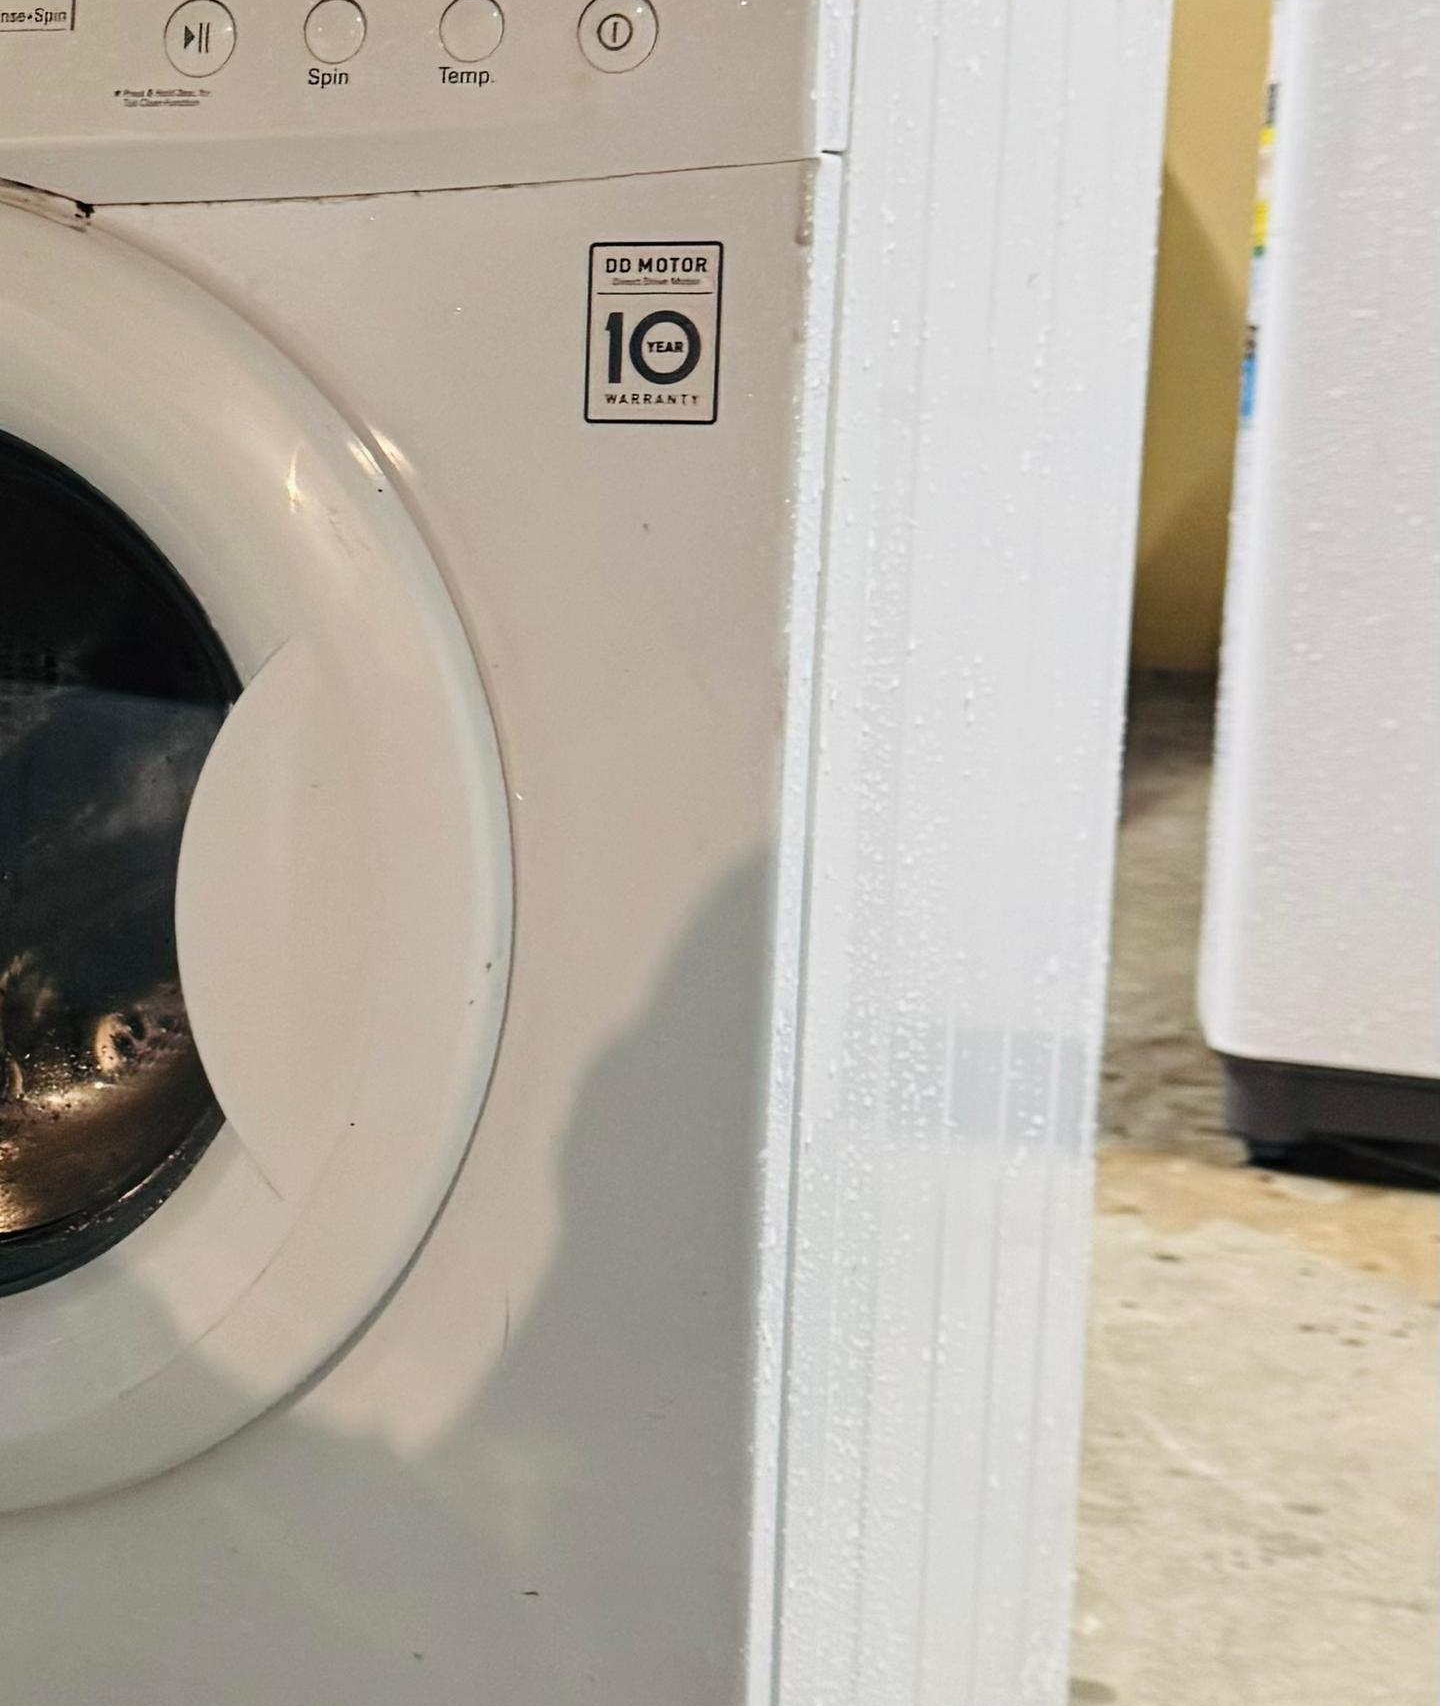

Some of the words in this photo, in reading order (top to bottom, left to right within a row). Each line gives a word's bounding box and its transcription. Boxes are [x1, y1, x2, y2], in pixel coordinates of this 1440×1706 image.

[308, 68, 349, 89] Spin
[438, 66, 496, 87] Temp.
[606, 258, 631, 273] DD
[638, 257, 707, 273] MOTOR
[605, 310, 701, 385] 10
[646, 341, 684, 353] YEAR
[605, 394, 700, 405] WARRANTY
